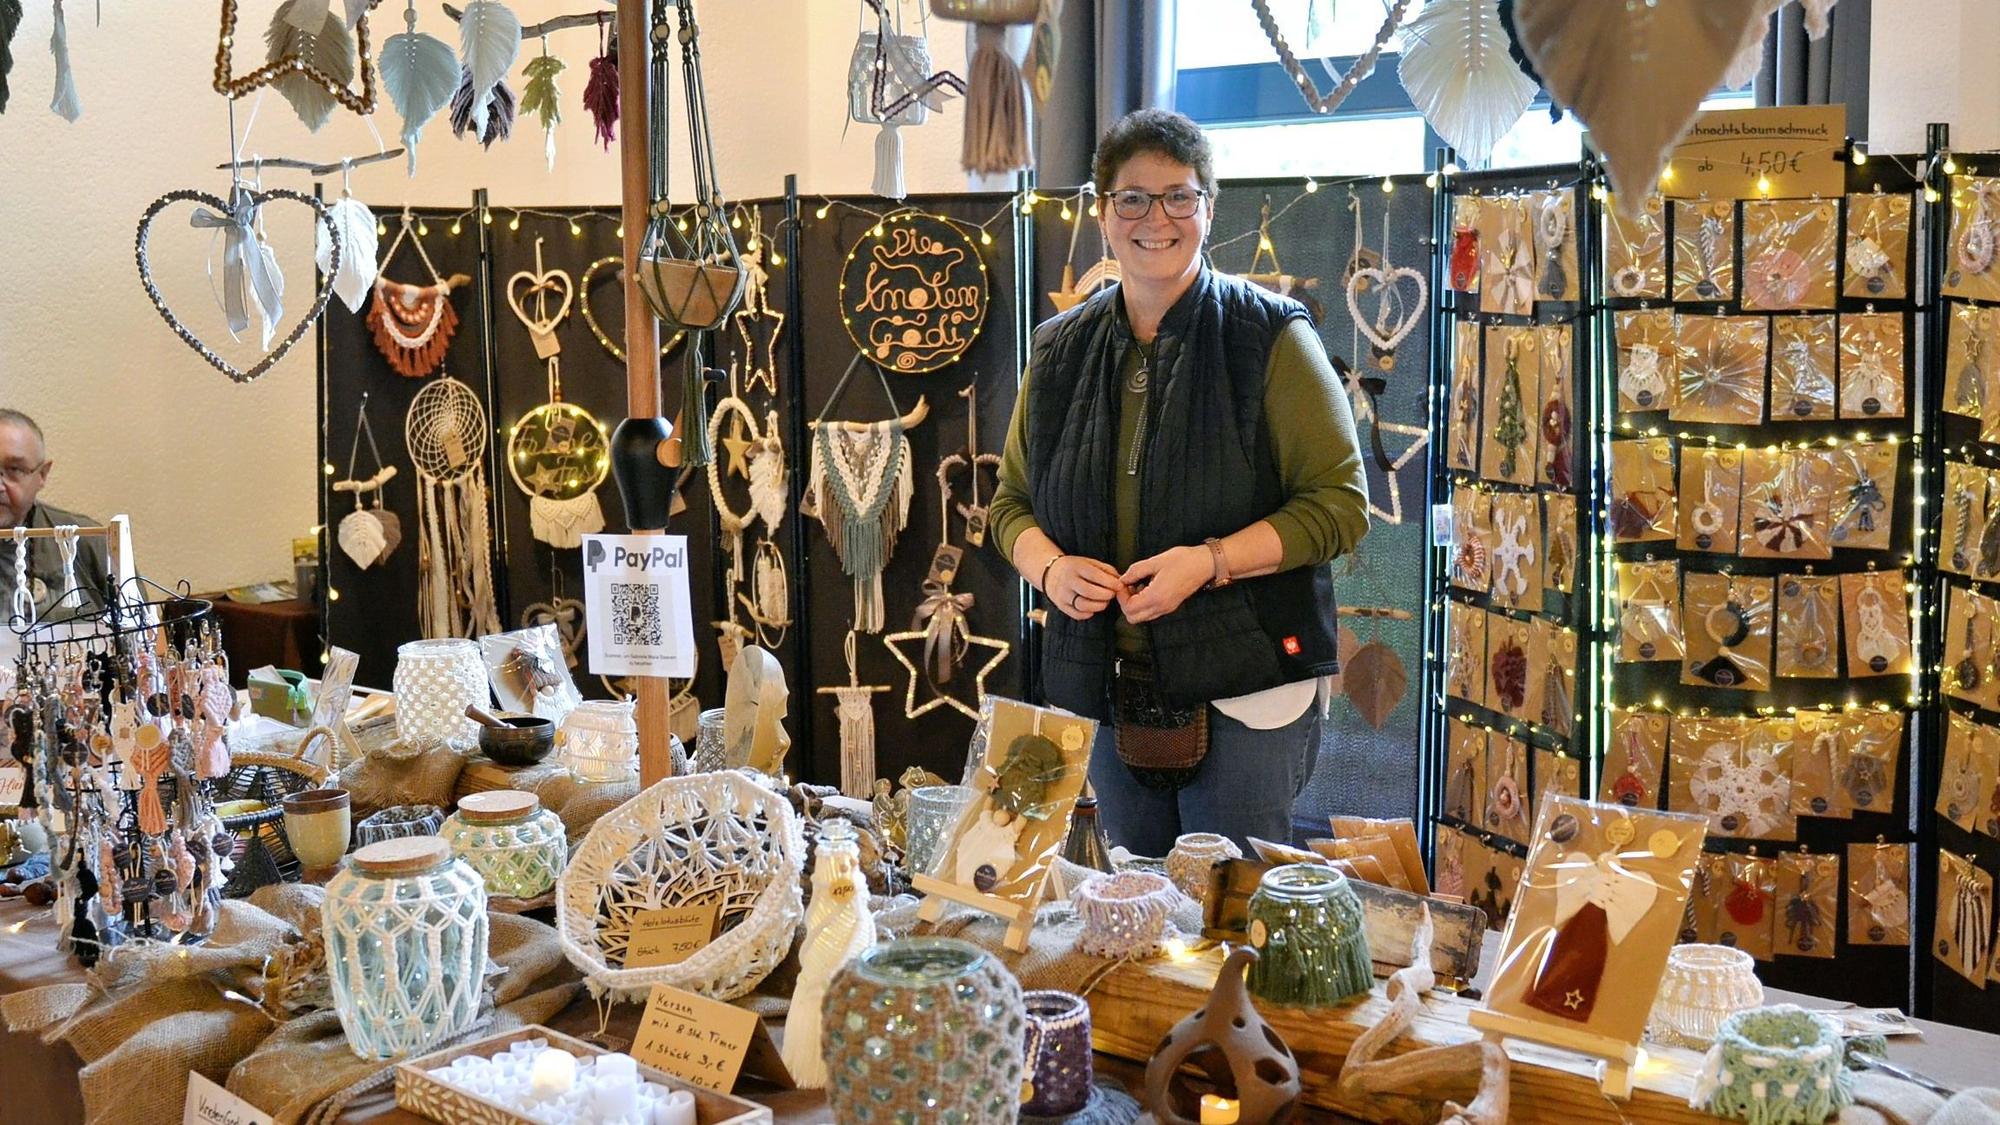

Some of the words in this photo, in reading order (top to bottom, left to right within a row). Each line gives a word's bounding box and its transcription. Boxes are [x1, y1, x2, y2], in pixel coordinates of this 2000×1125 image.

[1697, 156, 1714, 173] ab
[614, 546, 683, 571] PayPal
[656, 992, 693, 1015] Kerzen
[652, 1019, 669, 1029] mit
[709, 1031, 738, 1050] Timer
[644, 1040, 653, 1050] 1
[656, 1043, 690, 1062] Stück
